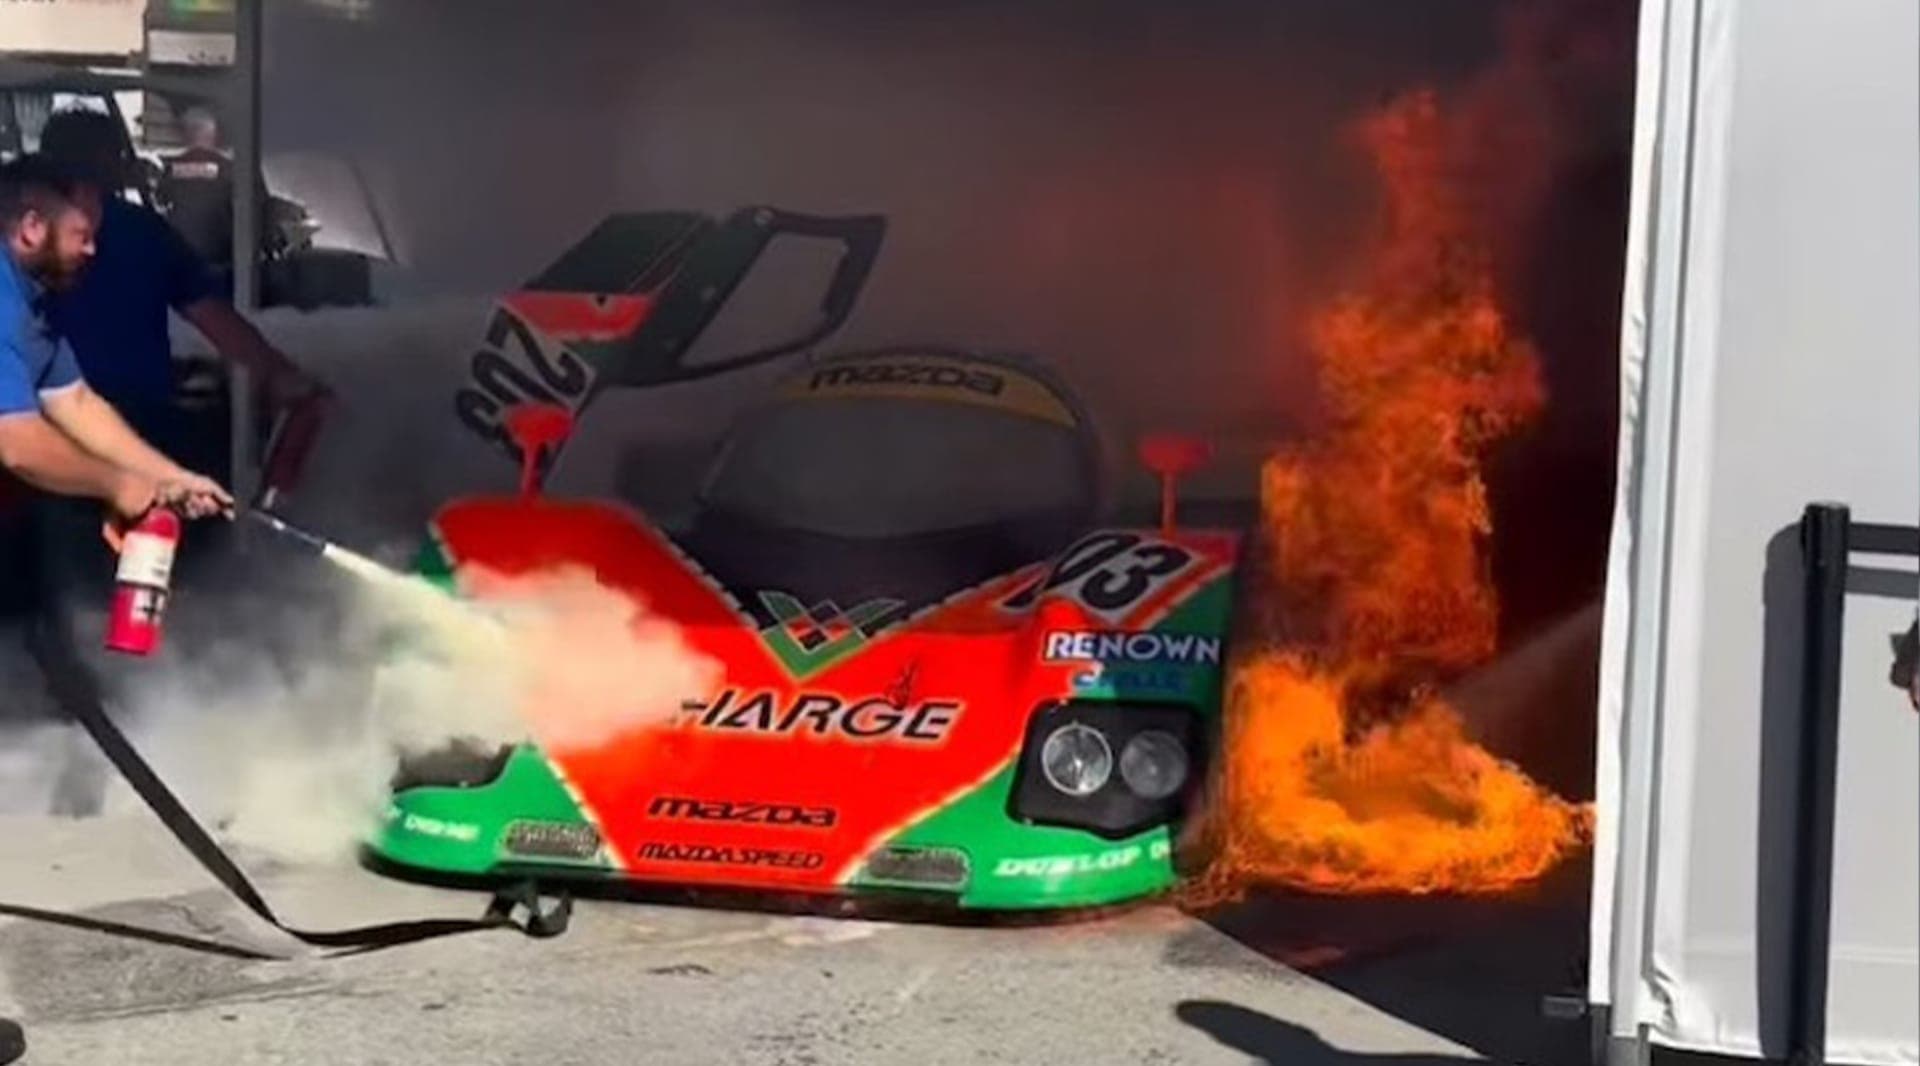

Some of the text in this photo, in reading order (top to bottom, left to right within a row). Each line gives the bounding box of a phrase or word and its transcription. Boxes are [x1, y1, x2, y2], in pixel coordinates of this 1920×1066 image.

[809, 364, 1005, 396] mazda
[1045, 631, 1221, 664] RENOWN
[681, 689, 960, 740] HARGE
[647, 797, 837, 828] mazda
[638, 842, 825, 869] MAZDASPEED
[993, 846, 1142, 877] DUNLOP
